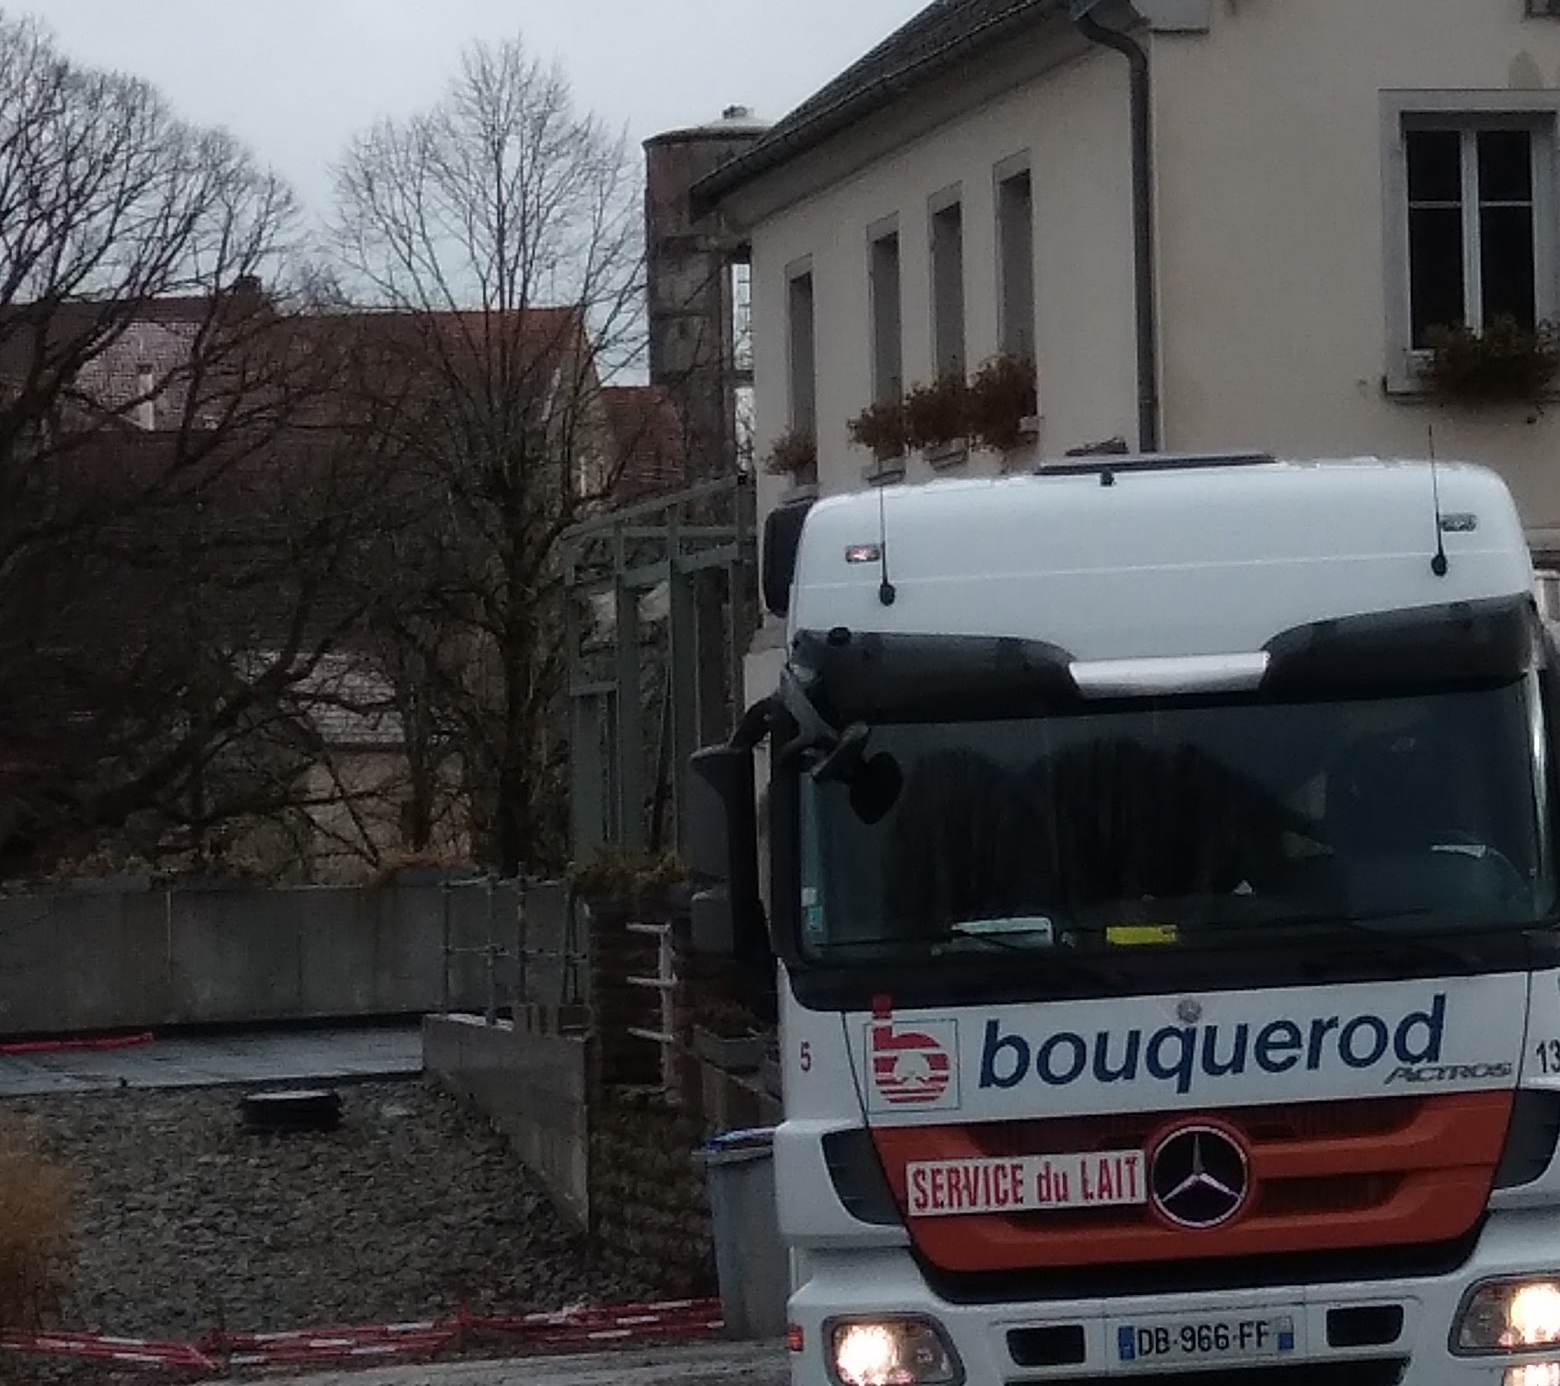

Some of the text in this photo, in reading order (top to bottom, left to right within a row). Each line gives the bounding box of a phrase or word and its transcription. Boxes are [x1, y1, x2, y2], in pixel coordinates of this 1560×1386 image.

[799, 1040, 812, 1073] 5
[978, 993, 1447, 1094] bouquerod
[1383, 1061, 1513, 1085] ACTROS
[911, 1155, 1139, 1211] SERVICE du LAIT
